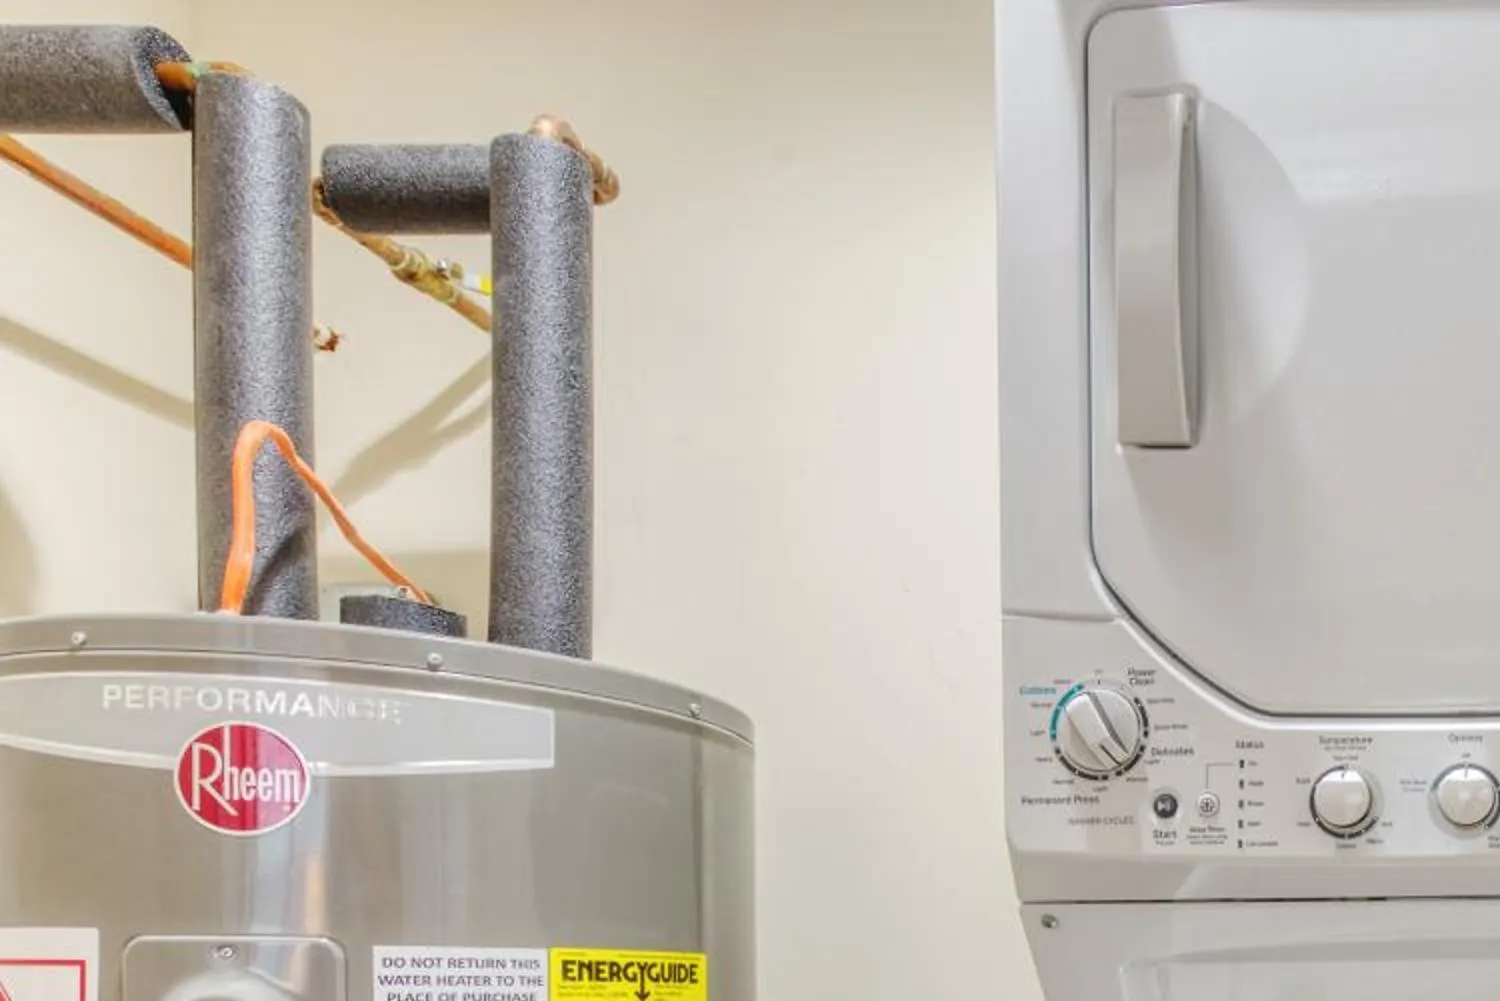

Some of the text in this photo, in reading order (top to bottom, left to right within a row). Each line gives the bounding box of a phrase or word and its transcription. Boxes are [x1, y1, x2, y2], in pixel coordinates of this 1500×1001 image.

[192, 724, 303, 817] Rheem
[1153, 830, 1177, 840] Start
[382, 957, 541, 970] DO NOT RETURN THIS
[378, 975, 545, 987] WATER HEATER TO THE
[561, 959, 699, 992] ENERGYGUIDE
